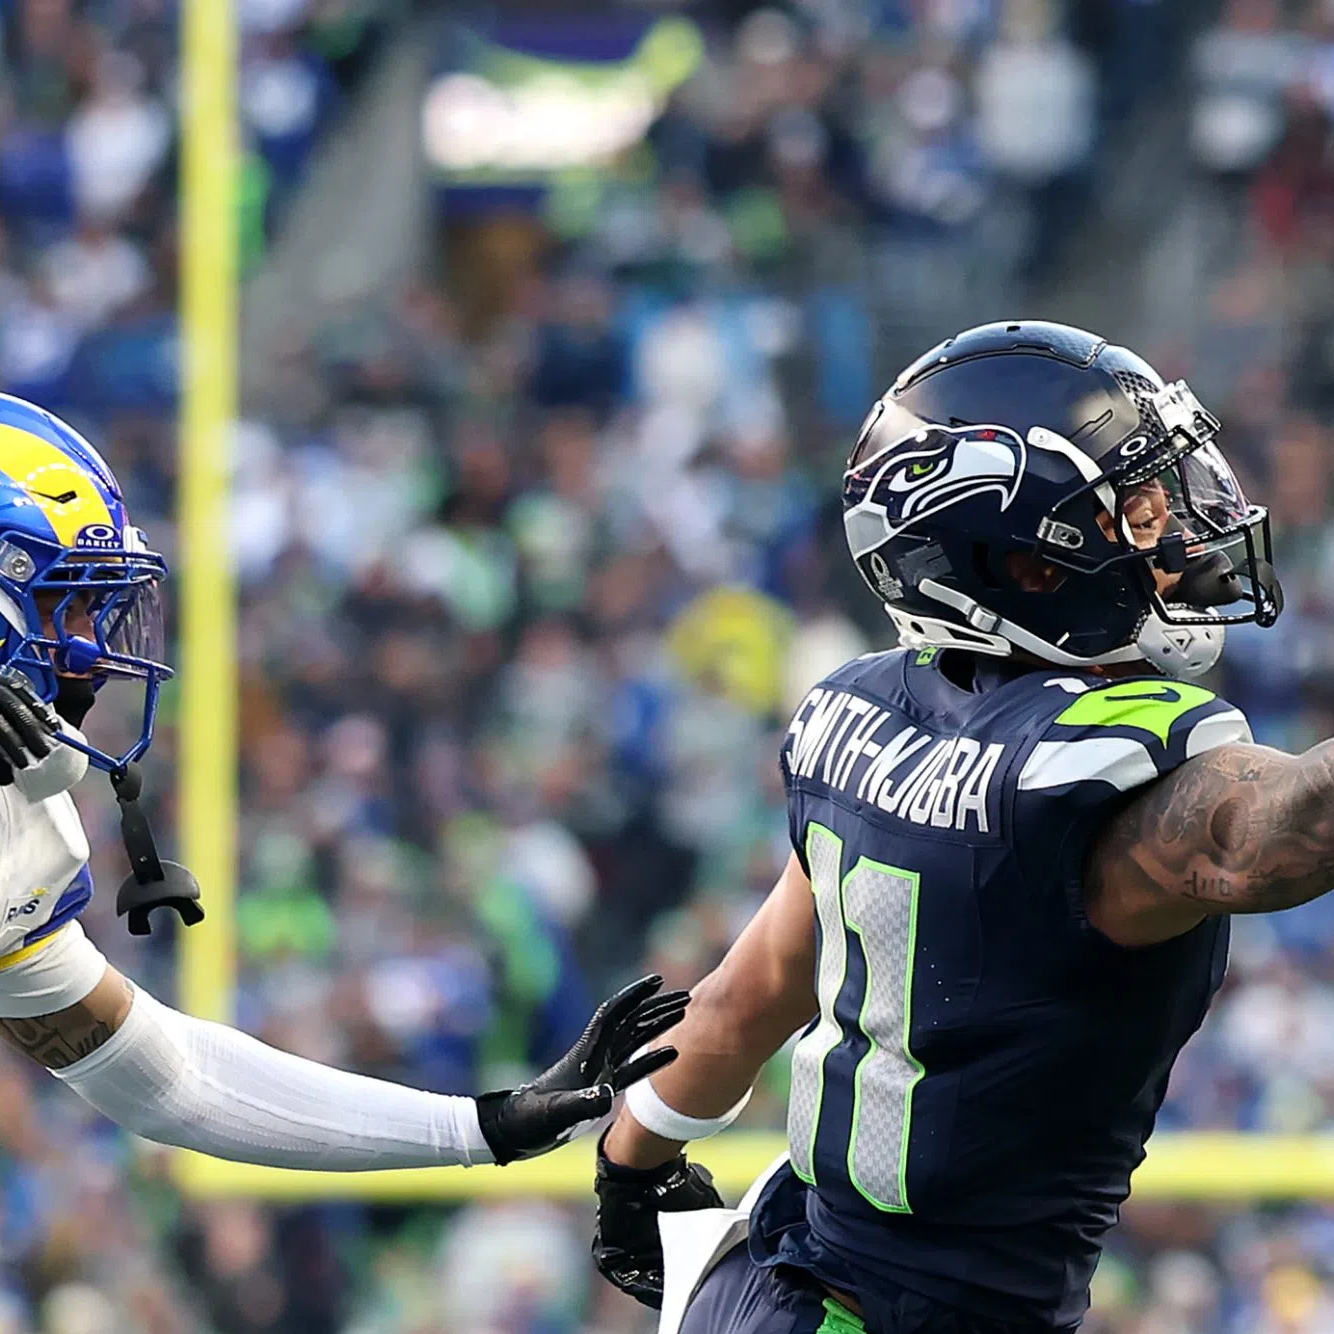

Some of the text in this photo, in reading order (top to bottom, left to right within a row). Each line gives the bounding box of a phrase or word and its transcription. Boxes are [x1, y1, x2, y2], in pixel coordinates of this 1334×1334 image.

[78, 538, 120, 548] OAKLEY
[786, 688, 1005, 833] SMITH-NJIGBA
[788, 821, 925, 1213] 11
